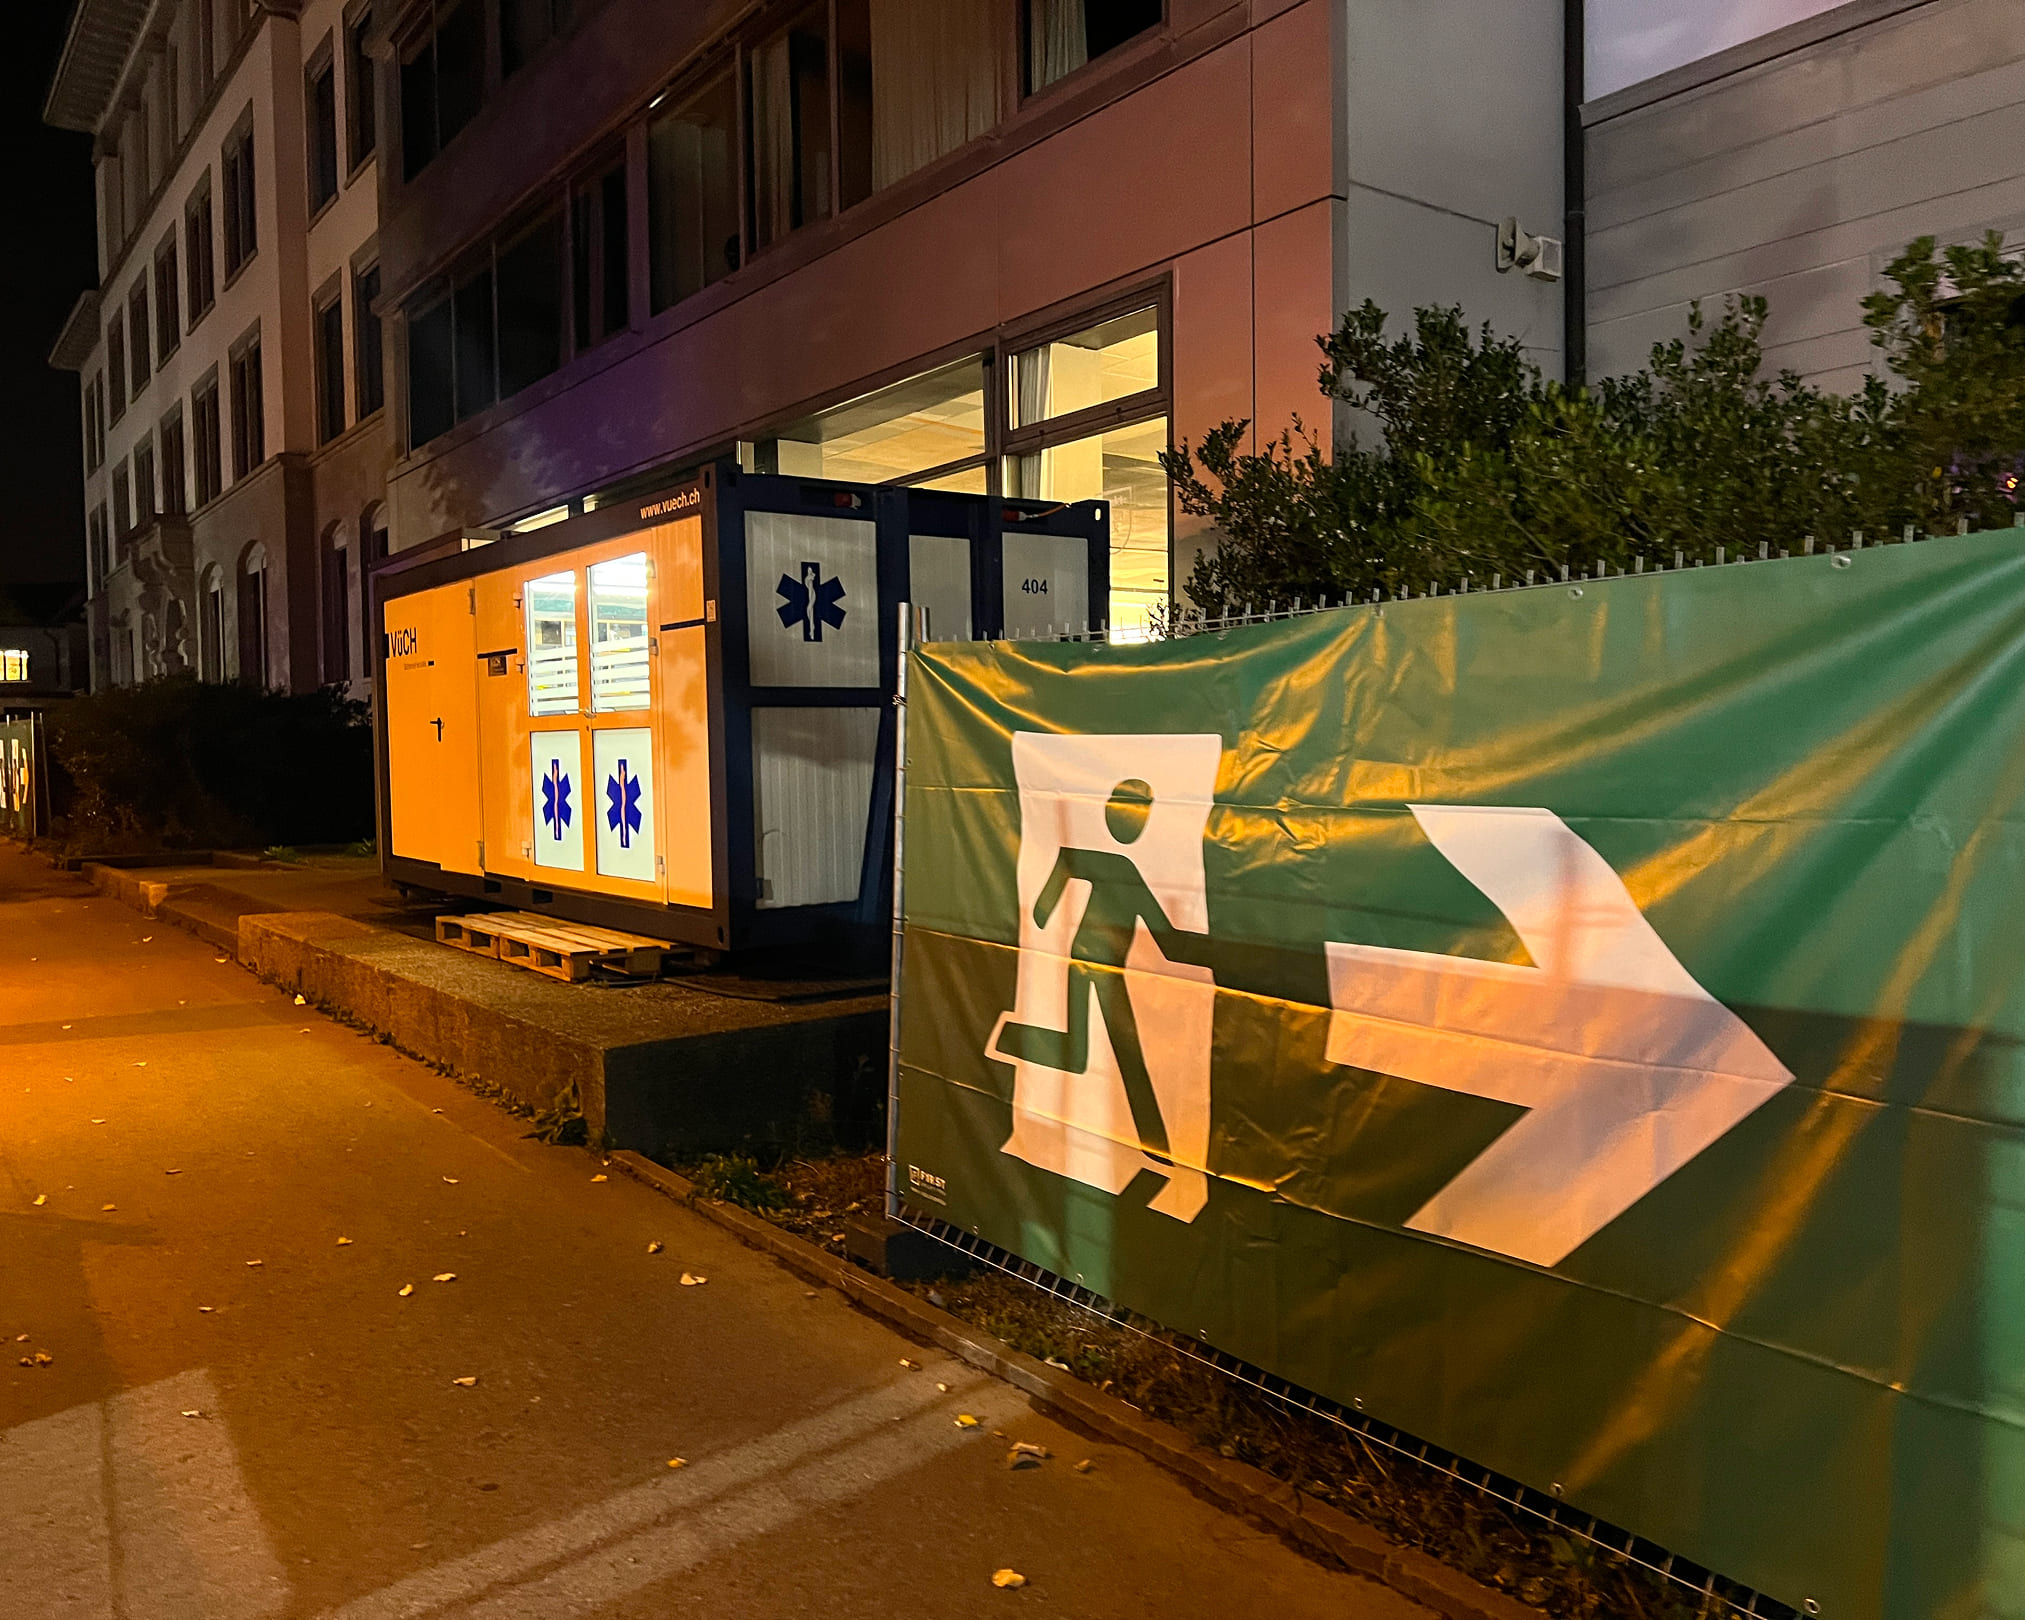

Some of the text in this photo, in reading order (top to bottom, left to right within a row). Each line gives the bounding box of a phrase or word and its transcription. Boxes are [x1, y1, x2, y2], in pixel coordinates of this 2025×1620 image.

[640, 487, 700, 519] www.vuech.ch
[1021, 578, 1048, 595] 404
[390, 626, 417, 657] VüCH
